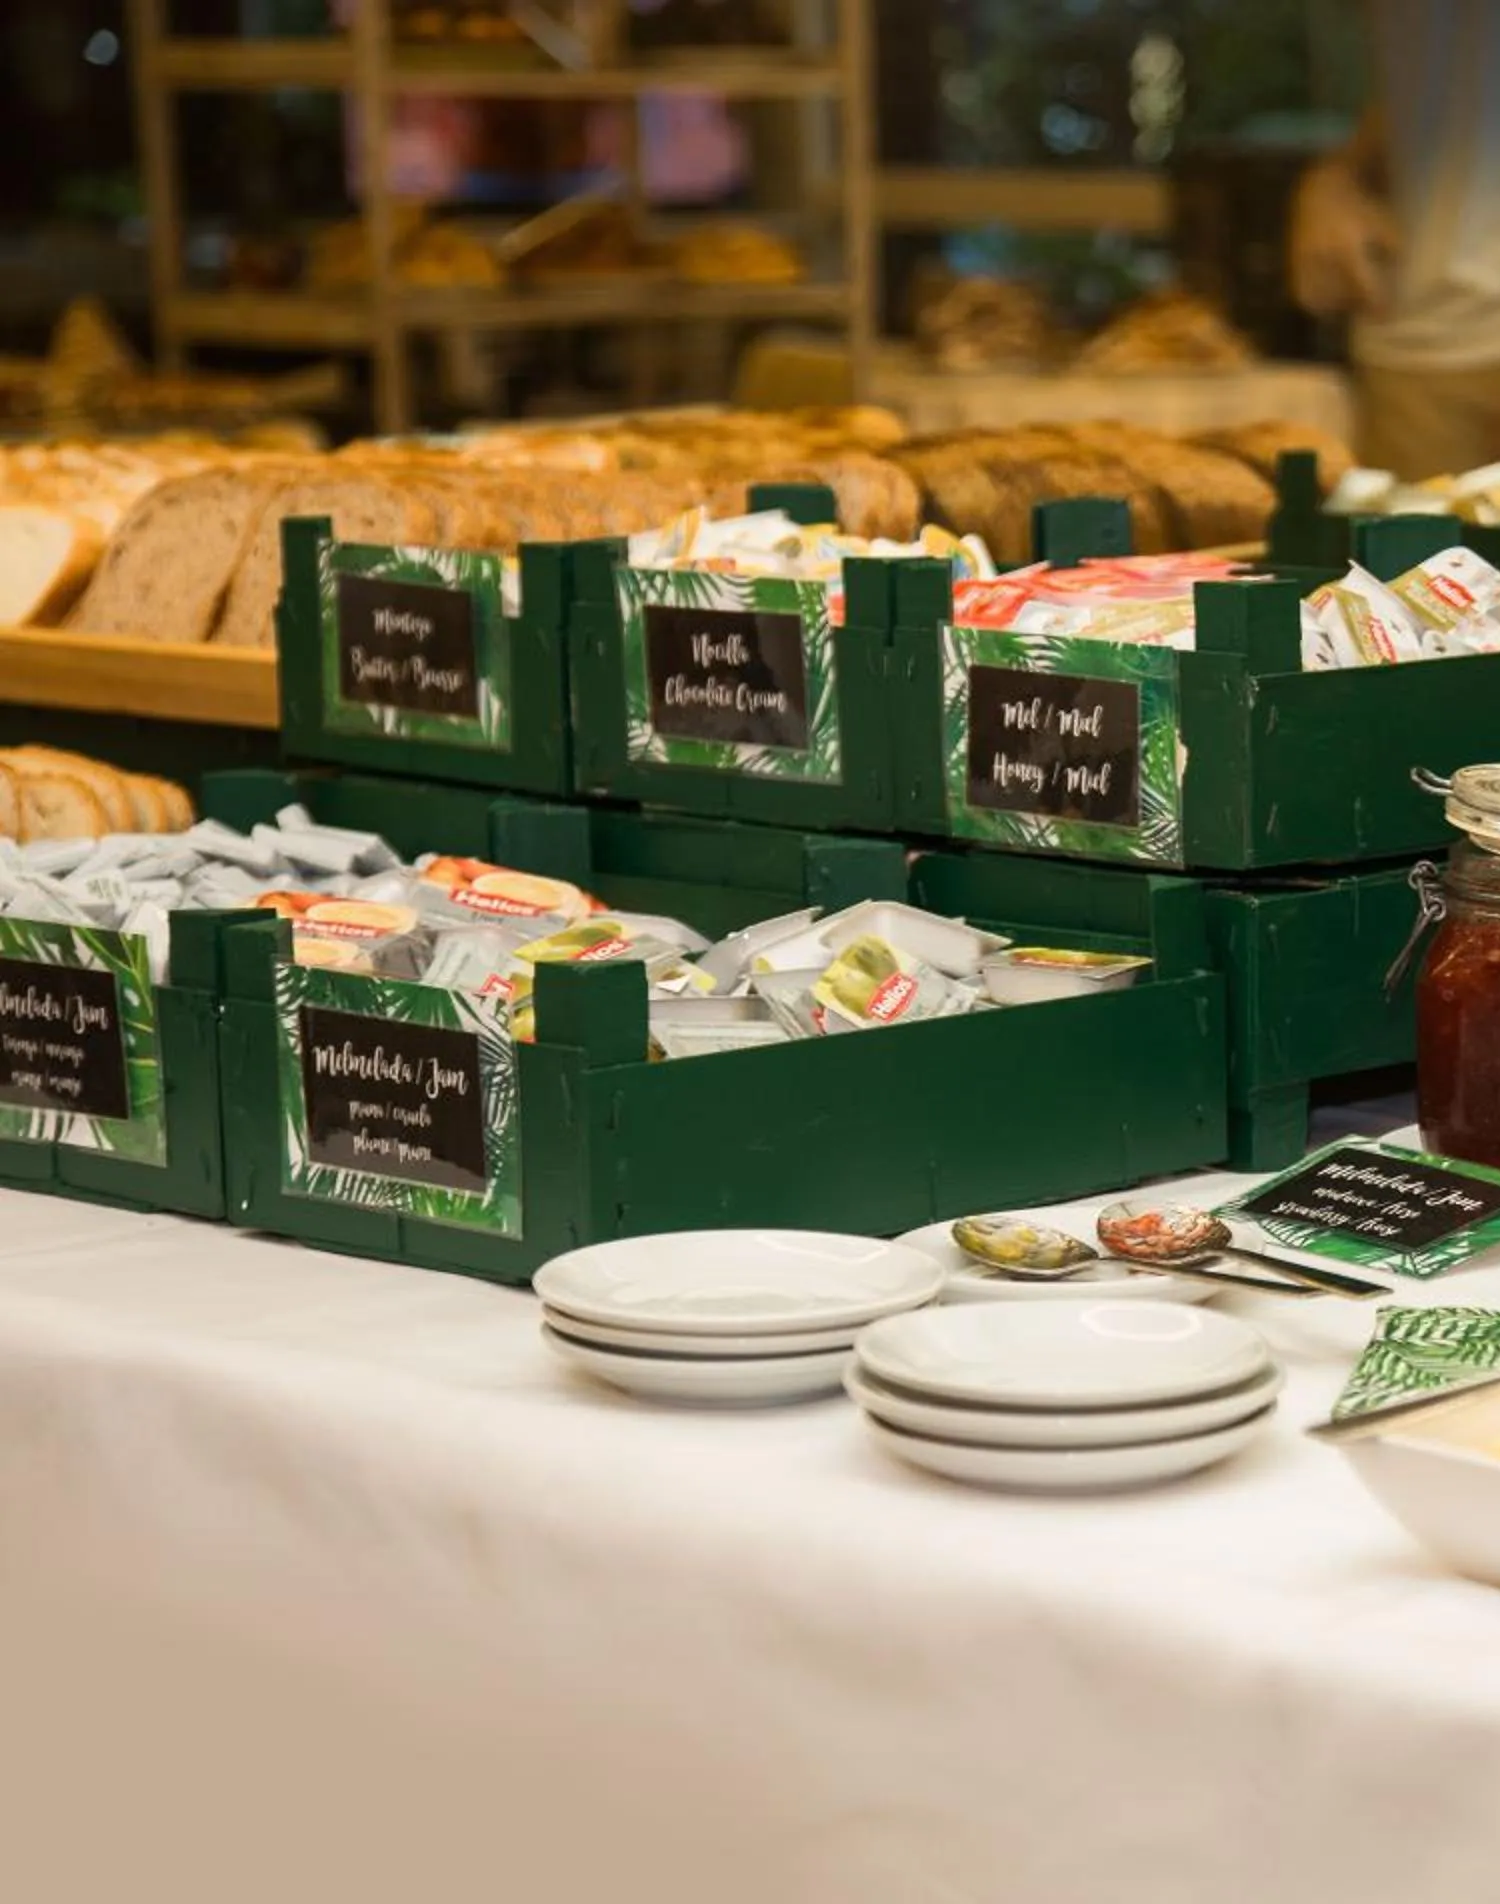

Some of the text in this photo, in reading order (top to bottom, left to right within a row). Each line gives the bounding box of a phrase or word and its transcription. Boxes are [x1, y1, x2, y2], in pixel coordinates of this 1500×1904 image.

[665, 672, 788, 713] Chocolate Cream
[1002, 697, 1041, 729] Mel
[1056, 705, 1104, 738] Miel
[993, 752, 1046, 794] Honey
[1065, 763, 1112, 796] Miel
[0, 981, 61, 1021] lmelada
[72, 995, 109, 1034] Jam
[312, 1041, 412, 1083] Melmelada
[425, 1057, 469, 1099] Jam
